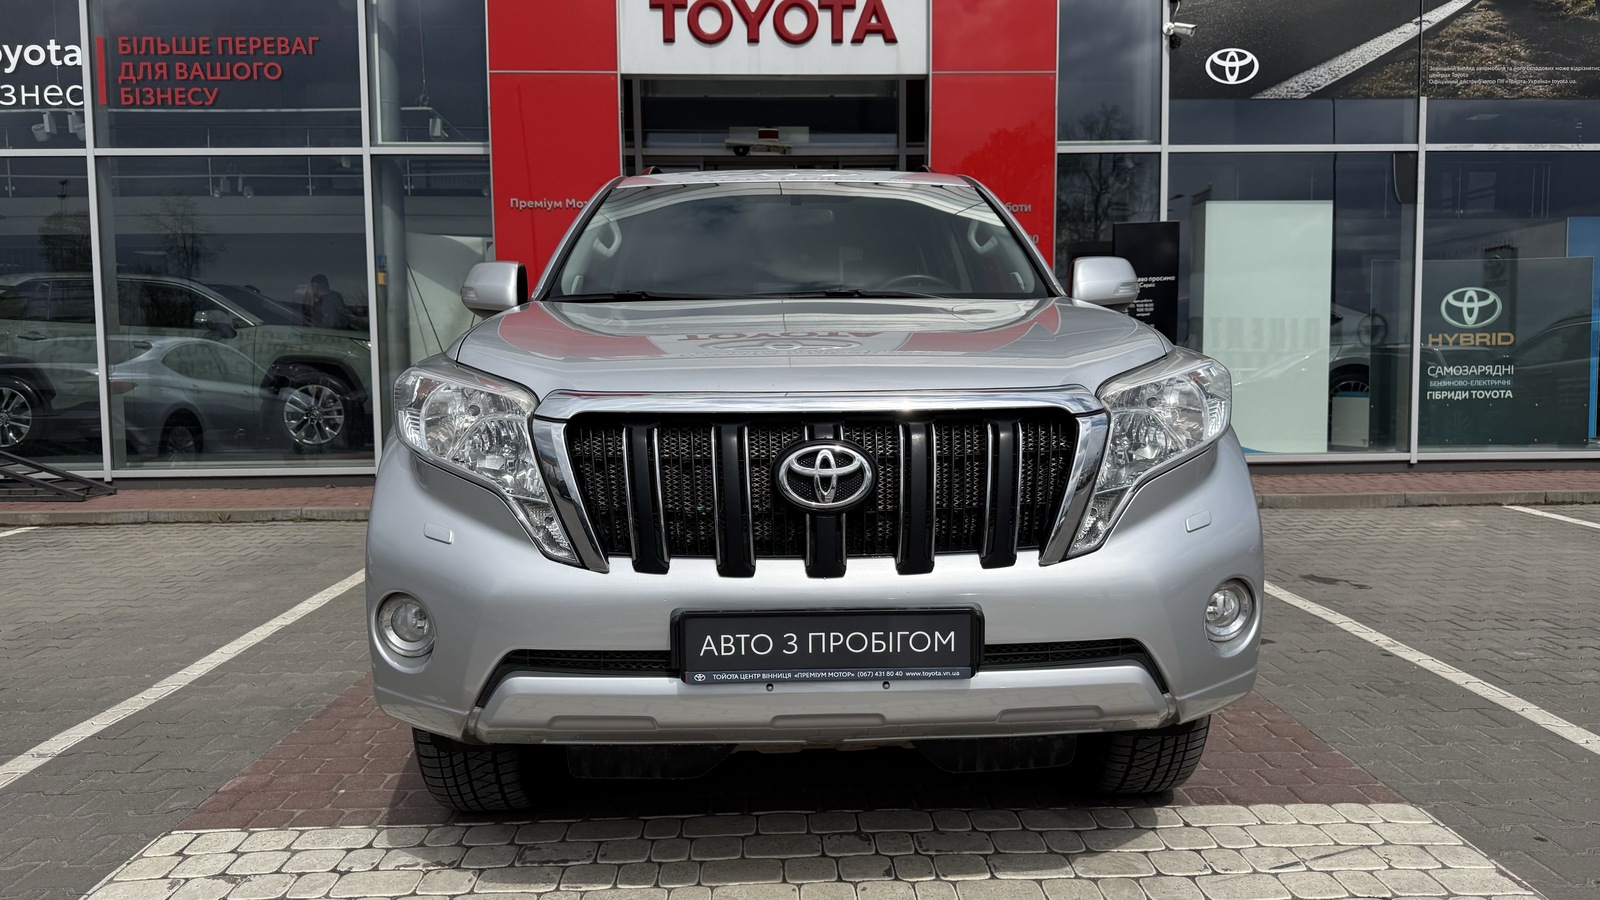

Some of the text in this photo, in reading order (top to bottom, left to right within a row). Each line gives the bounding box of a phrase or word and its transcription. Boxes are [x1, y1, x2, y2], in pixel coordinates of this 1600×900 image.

[649, 0, 898, 44] TOYOTA
[118, 36, 319, 55] БІЛЬШЕ ПЕРЕВАГ
[0, 39, 82, 74] yota
[118, 62, 283, 84] ДЛЯ ВАШОГО
[120, 87, 219, 106] БІЗНЕСУ
[510, 198, 562, 210] Преміум
[1428, 332, 1515, 347] HYBRID
[1427, 364, 1514, 377] САМОЗАРЯДНІ
[1426, 389, 1513, 400] ГІБРИДИ TOYOTA
[700, 630, 956, 657] АВТО З ПРОБІГОМ
